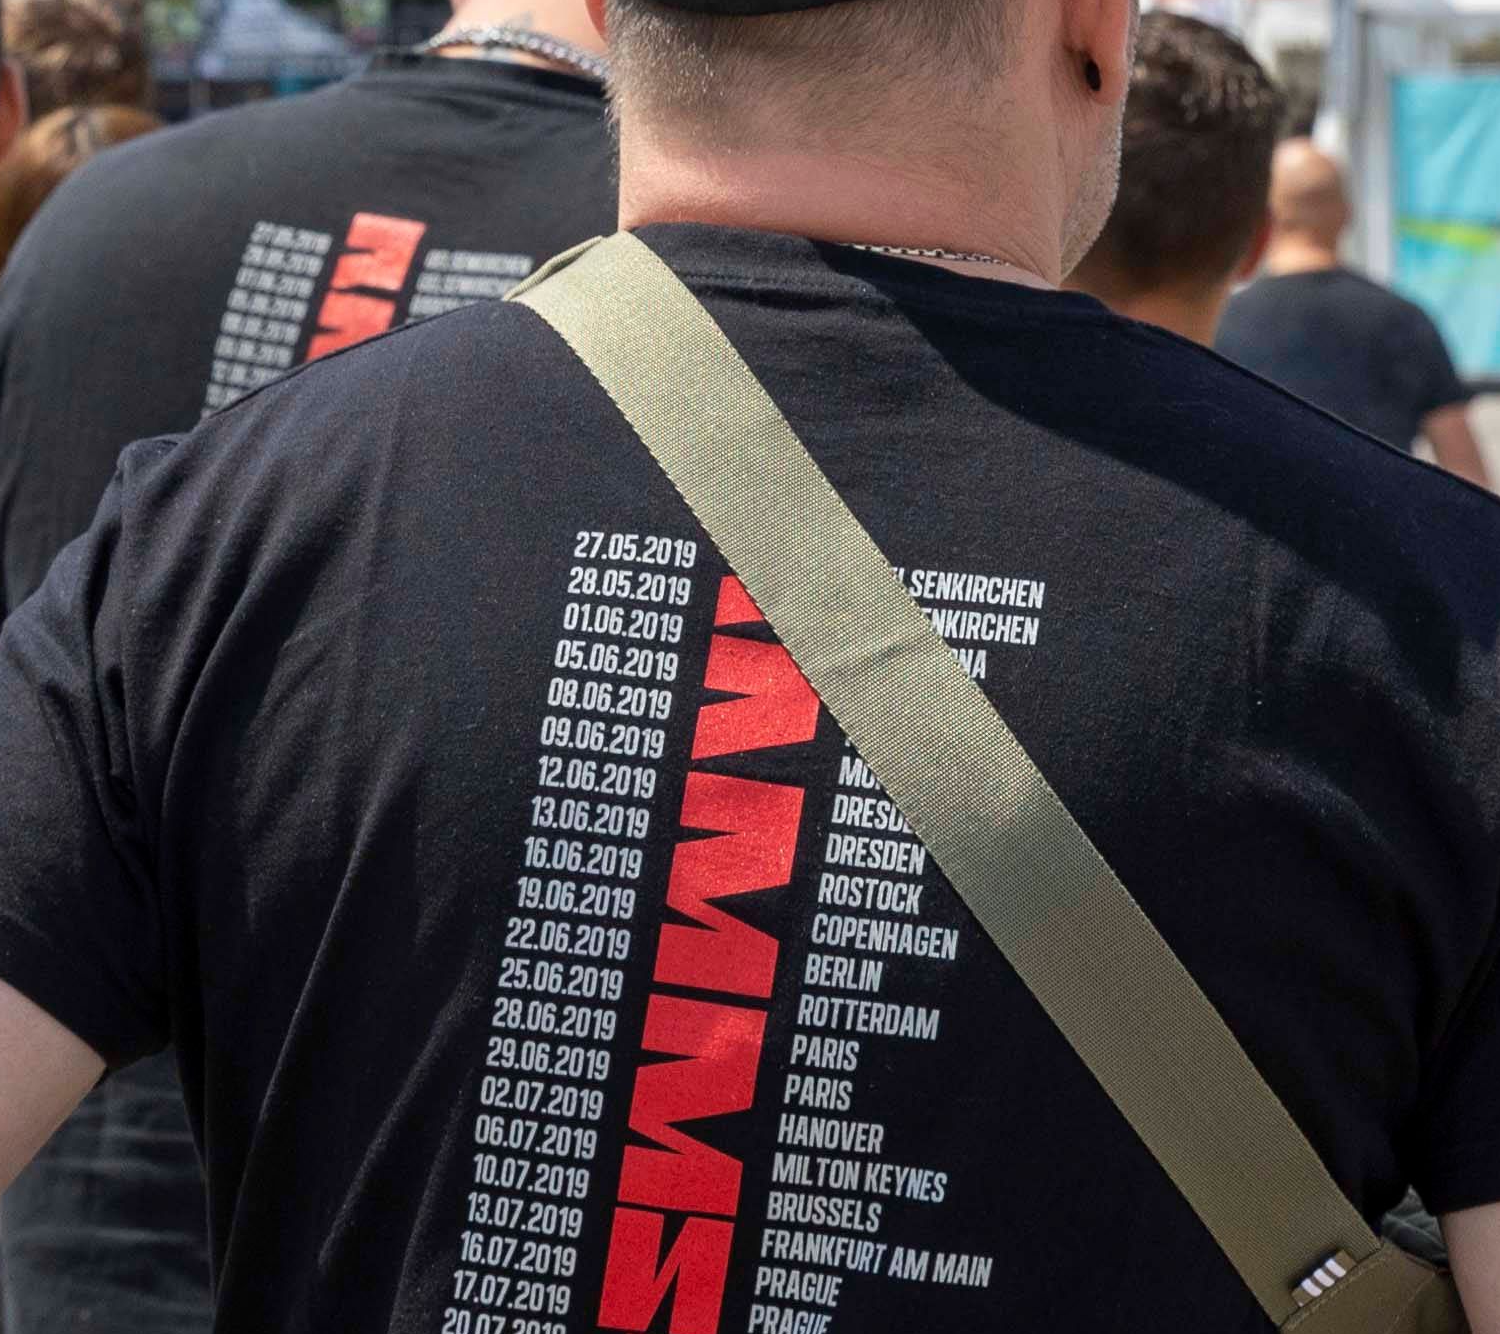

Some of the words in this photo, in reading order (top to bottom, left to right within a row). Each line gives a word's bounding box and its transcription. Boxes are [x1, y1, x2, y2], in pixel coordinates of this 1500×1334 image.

[572, 530, 698, 569] 27.05.2019
[565, 565, 692, 606] 28.05.2019
[561, 601, 684, 644] 01.06.2019
[552, 638, 680, 682] 05.06.2019
[545, 676, 673, 721] 08.06.2019
[539, 715, 666, 760] 09.06.2019
[537, 754, 657, 800] 12.06.2019
[530, 794, 650, 840] 13.06.2019
[523, 835, 644, 880] 16.06.2019
[824, 832, 926, 876] DRESDEN
[516, 876, 636, 920] 19.06.2019
[816, 872, 924, 916] ROSTOCK
[503, 916, 631, 961] 22.06.2019
[810, 912, 959, 961] COPENHAGEN
[497, 956, 624, 1001] 25.06.2019
[803, 952, 884, 993] BERLIN
[490, 996, 617, 1041] 28.06.2019
[796, 993, 940, 1041] ROTTERDAM
[485, 1036, 611, 1081] 29.06.2019
[789, 1034, 860, 1072] PARIS
[479, 1075, 604, 1121] 02.07.2019
[782, 1073, 853, 1111] PARIS
[473, 1114, 598, 1160] 06.07.2019
[776, 1112, 884, 1154] HANOVER
[472, 1153, 590, 1199] 10.07.2019
[771, 1152, 862, 1191] MILTON
[864, 1165, 948, 1203] KEYNES
[467, 1191, 583, 1238] 13.07.2019
[765, 1191, 882, 1233] BRUSSELS
[459, 1230, 577, 1277] 16.07.2019
[759, 1228, 888, 1275] FRANKFURT
[888, 1246, 931, 1282] AM
[932, 1252, 993, 1288] MAIN
[452, 1269, 571, 1315] 17.07.2019
[753, 1266, 843, 1308] PRAGUE
